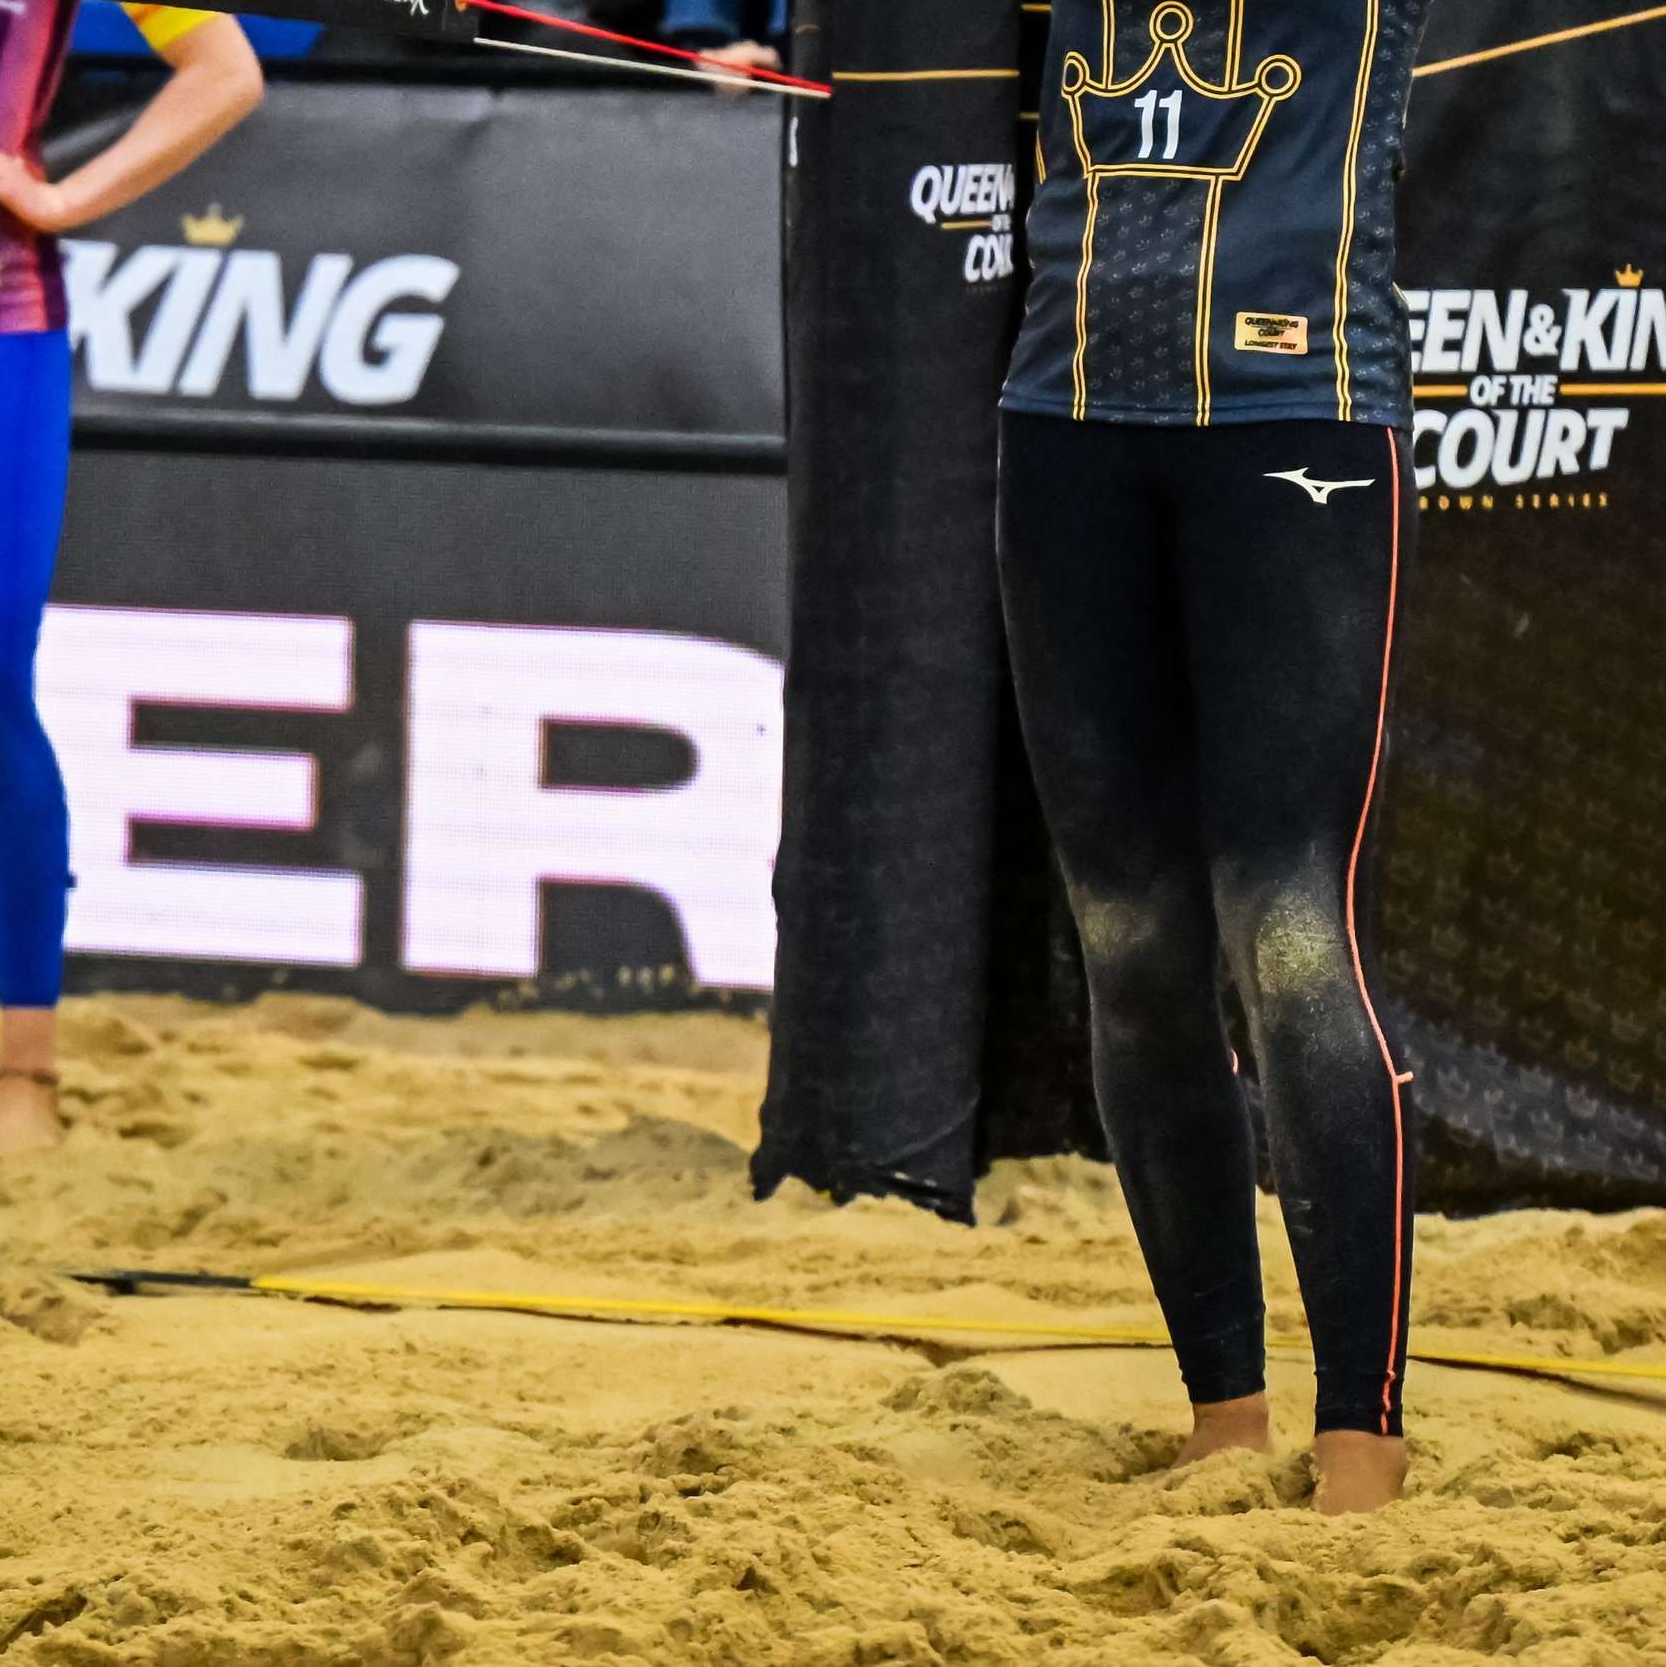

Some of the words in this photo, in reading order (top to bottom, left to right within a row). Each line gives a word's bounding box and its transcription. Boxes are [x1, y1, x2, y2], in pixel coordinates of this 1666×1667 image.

[1134, 89, 1183, 160] 11
[1469, 374, 1506, 406] OF
[1506, 374, 1559, 406] THE
[1412, 407, 1630, 489] COURT
